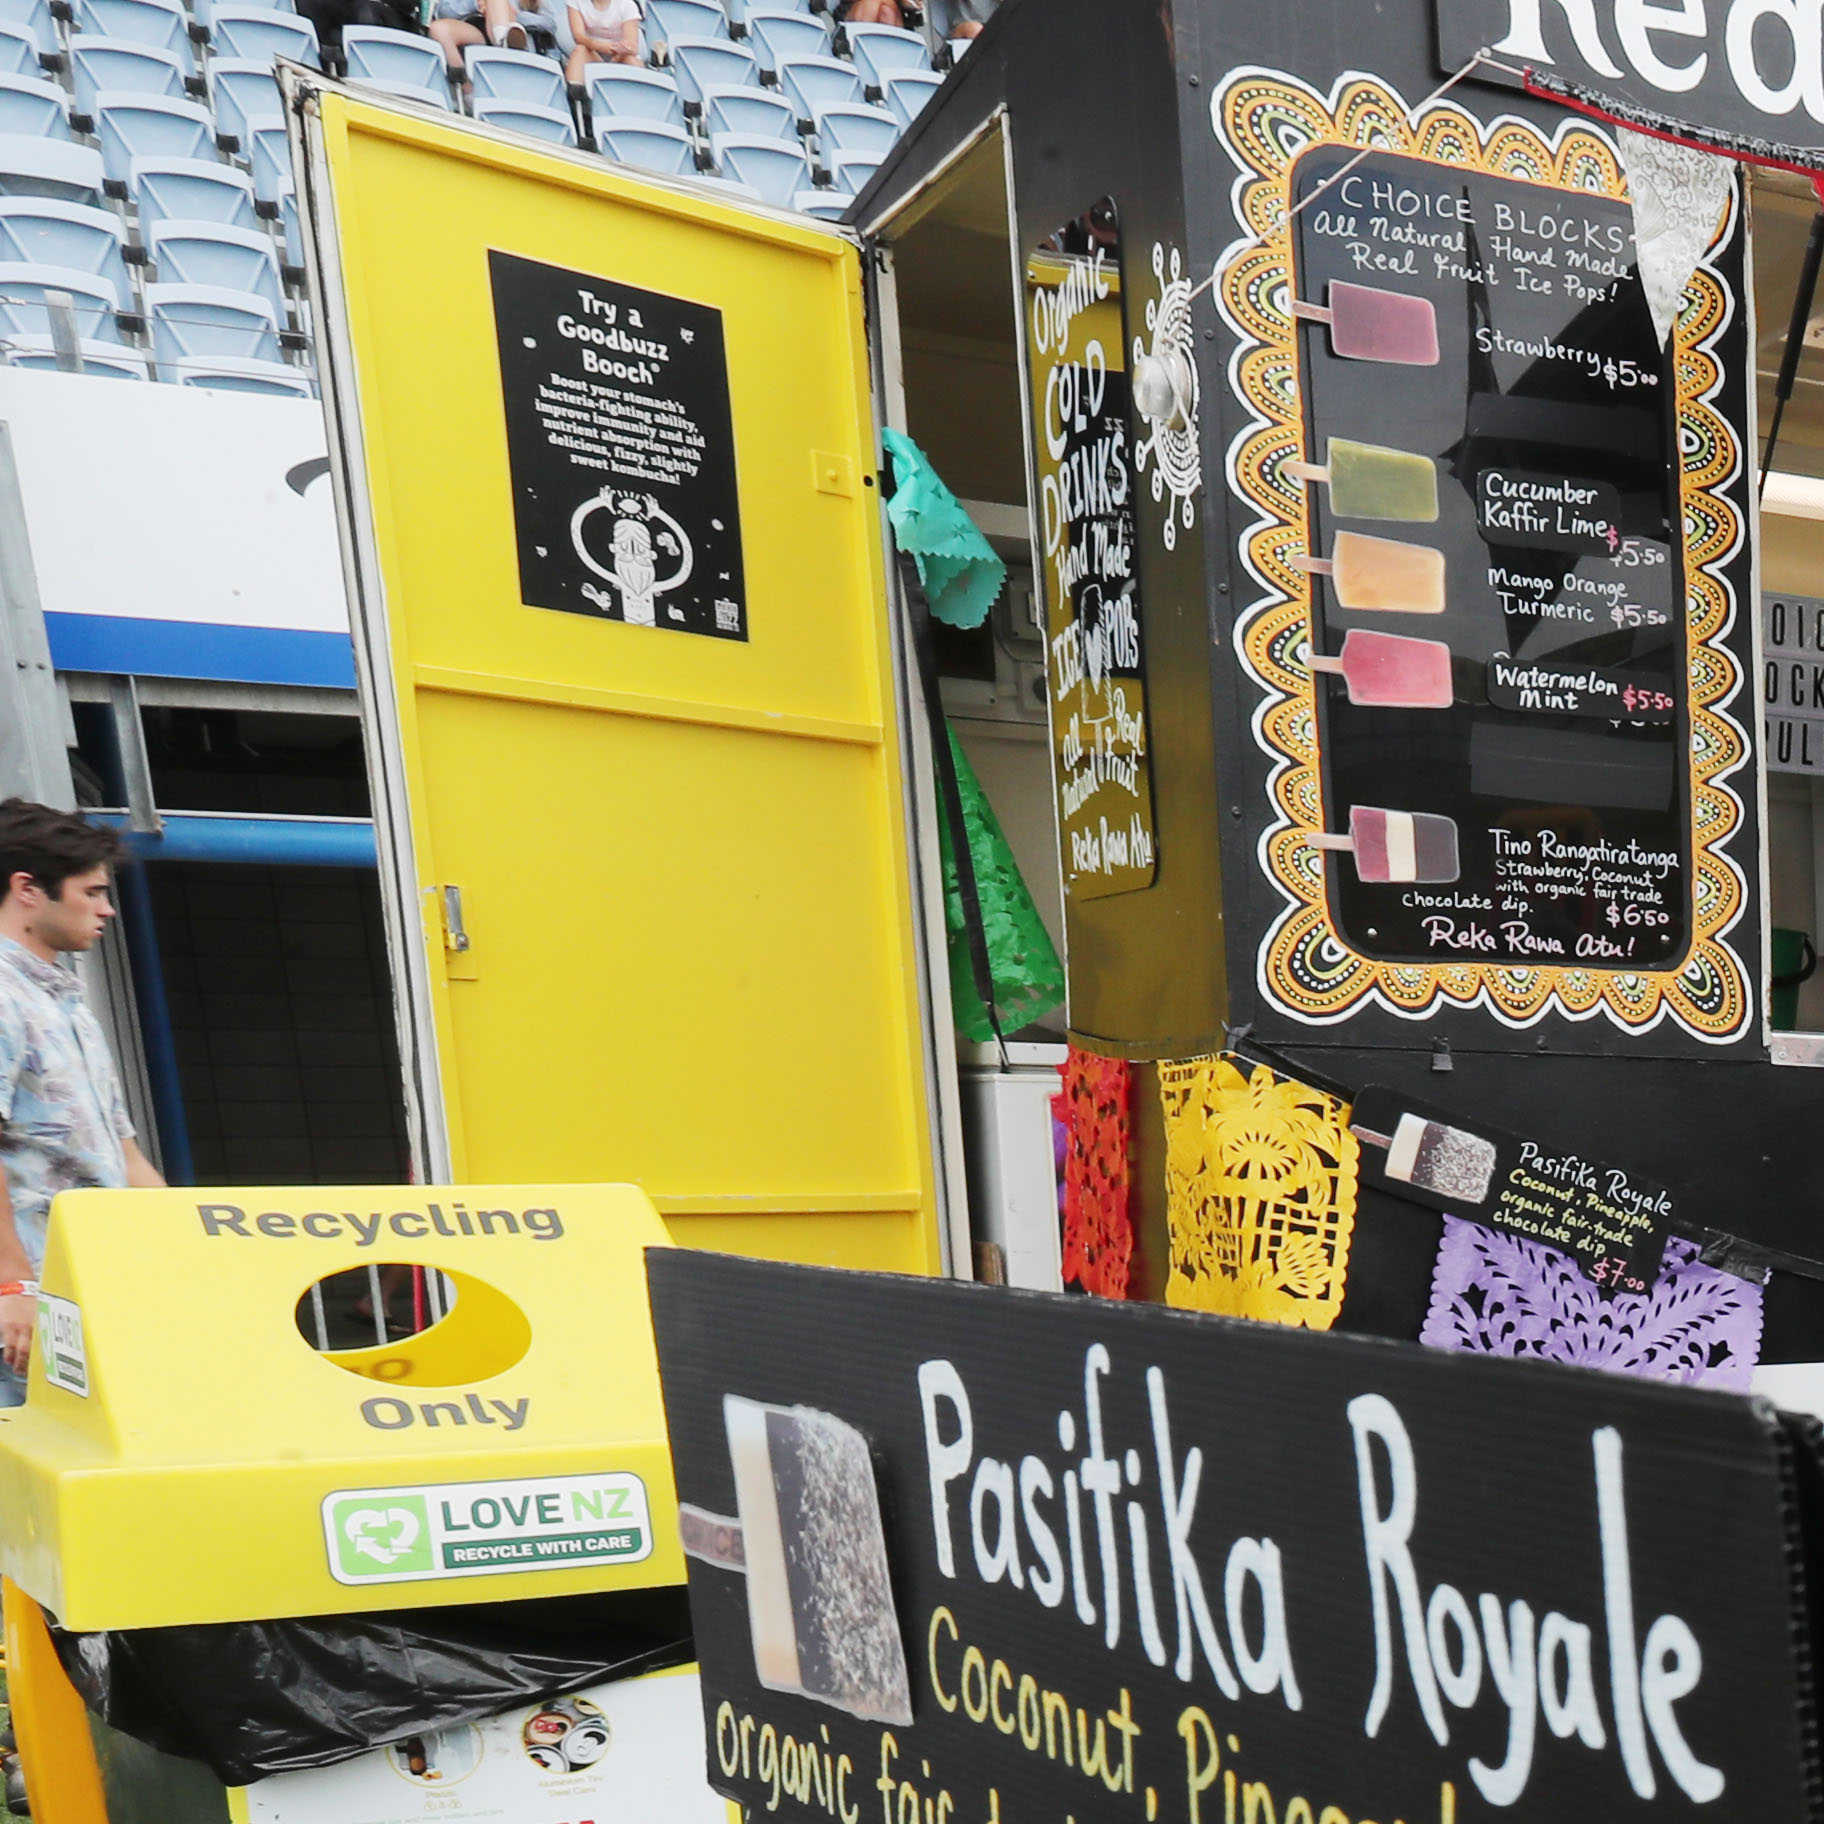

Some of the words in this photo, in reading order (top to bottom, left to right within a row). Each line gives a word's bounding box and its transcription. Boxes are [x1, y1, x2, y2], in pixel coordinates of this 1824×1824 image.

[1341, 176, 1476, 224] CHOICE
[1495, 204, 1623, 253] BLOCKS
[1370, 217, 1467, 251] Natural
[1490, 235, 1556, 268] Hand
[1033, 235, 1109, 356] Organic
[1346, 242, 1418, 275] Real
[1434, 254, 1499, 286] Fruit
[1514, 267, 1552, 294] Ice
[1564, 274, 1618, 305] Pops!
[577, 290, 617, 324] Try
[628, 310, 644, 328] a
[557, 315, 670, 362] Goodbuzz
[1475, 328, 1601, 377] Strawberry
[539, 383, 652, 423] bacteria-fighting
[550, 372, 588, 392] Boost
[590, 384, 621, 399] your
[623, 391, 686, 414] stomach's
[1045, 339, 1105, 461] COLD
[535, 398, 590, 422] improve
[593, 411, 657, 439] immunity
[659, 428, 684, 444] and
[685, 433, 706, 448] aid
[542, 418, 599, 439] nutrient
[601, 430, 670, 455] absorption
[672, 446, 701, 462] with
[548, 432, 611, 458] delicious,
[614, 446, 649, 466] fizzy,
[650, 454, 698, 477] slightly
[570, 453, 610, 470] sweet
[611, 460, 681, 485] kombucha!
[1041, 431, 1127, 558] DRINKS
[1486, 472, 1598, 505] Cucumber
[1484, 500, 1550, 533] Kaffir
[1556, 506, 1609, 538] Lime
[1055, 522, 1089, 610] Hand
[1488, 568, 1554, 600] Mango
[1563, 572, 1629, 607] Orange
[1496, 590, 1594, 623] Turmeric
[1610, 604, 1668, 629] $5.50
[1495, 664, 1618, 696] Watermelon
[1622, 684, 1674, 712] $5.50
[1520, 689, 1579, 710] Mint
[1488, 828, 1532, 855] Tino
[1537, 829, 1680, 880] Rangatiratanga
[1495, 879, 1530, 894] with
[1535, 882, 1587, 900] organic
[1593, 882, 1618, 900] fair
[1621, 886, 1664, 905] trade
[1592, 867, 1654, 888] Coconut
[1402, 891, 1492, 911] chocolate
[1605, 901, 1670, 929] $6.50
[1420, 915, 1497, 952] Reka
[1500, 921, 1565, 954] Rawa
[1585, 1192, 1654, 1234] Pineapple,
[1605, 1169, 1673, 1216] Royale
[196, 1202, 567, 1247] Recycling
[1492, 1208, 1571, 1243] chocolate
[1576, 1235, 1606, 1259] dip
[1500, 1190, 1555, 1214] organic
[1562, 1208, 1634, 1248] fair-trade
[1588, 1256, 1645, 1291] $7.00
[359, 1394, 531, 1432] Only
[441, 1493, 564, 1532] LOVE
[571, 1488, 634, 1521] NZ
[453, 1544, 534, 1563] RECYCLE
[536, 1538, 585, 1556] WITH
[585, 1534, 632, 1551] CARE
[917, 1341, 1304, 1712] Pasifika
[1346, 1392, 1727, 1809] Royale
